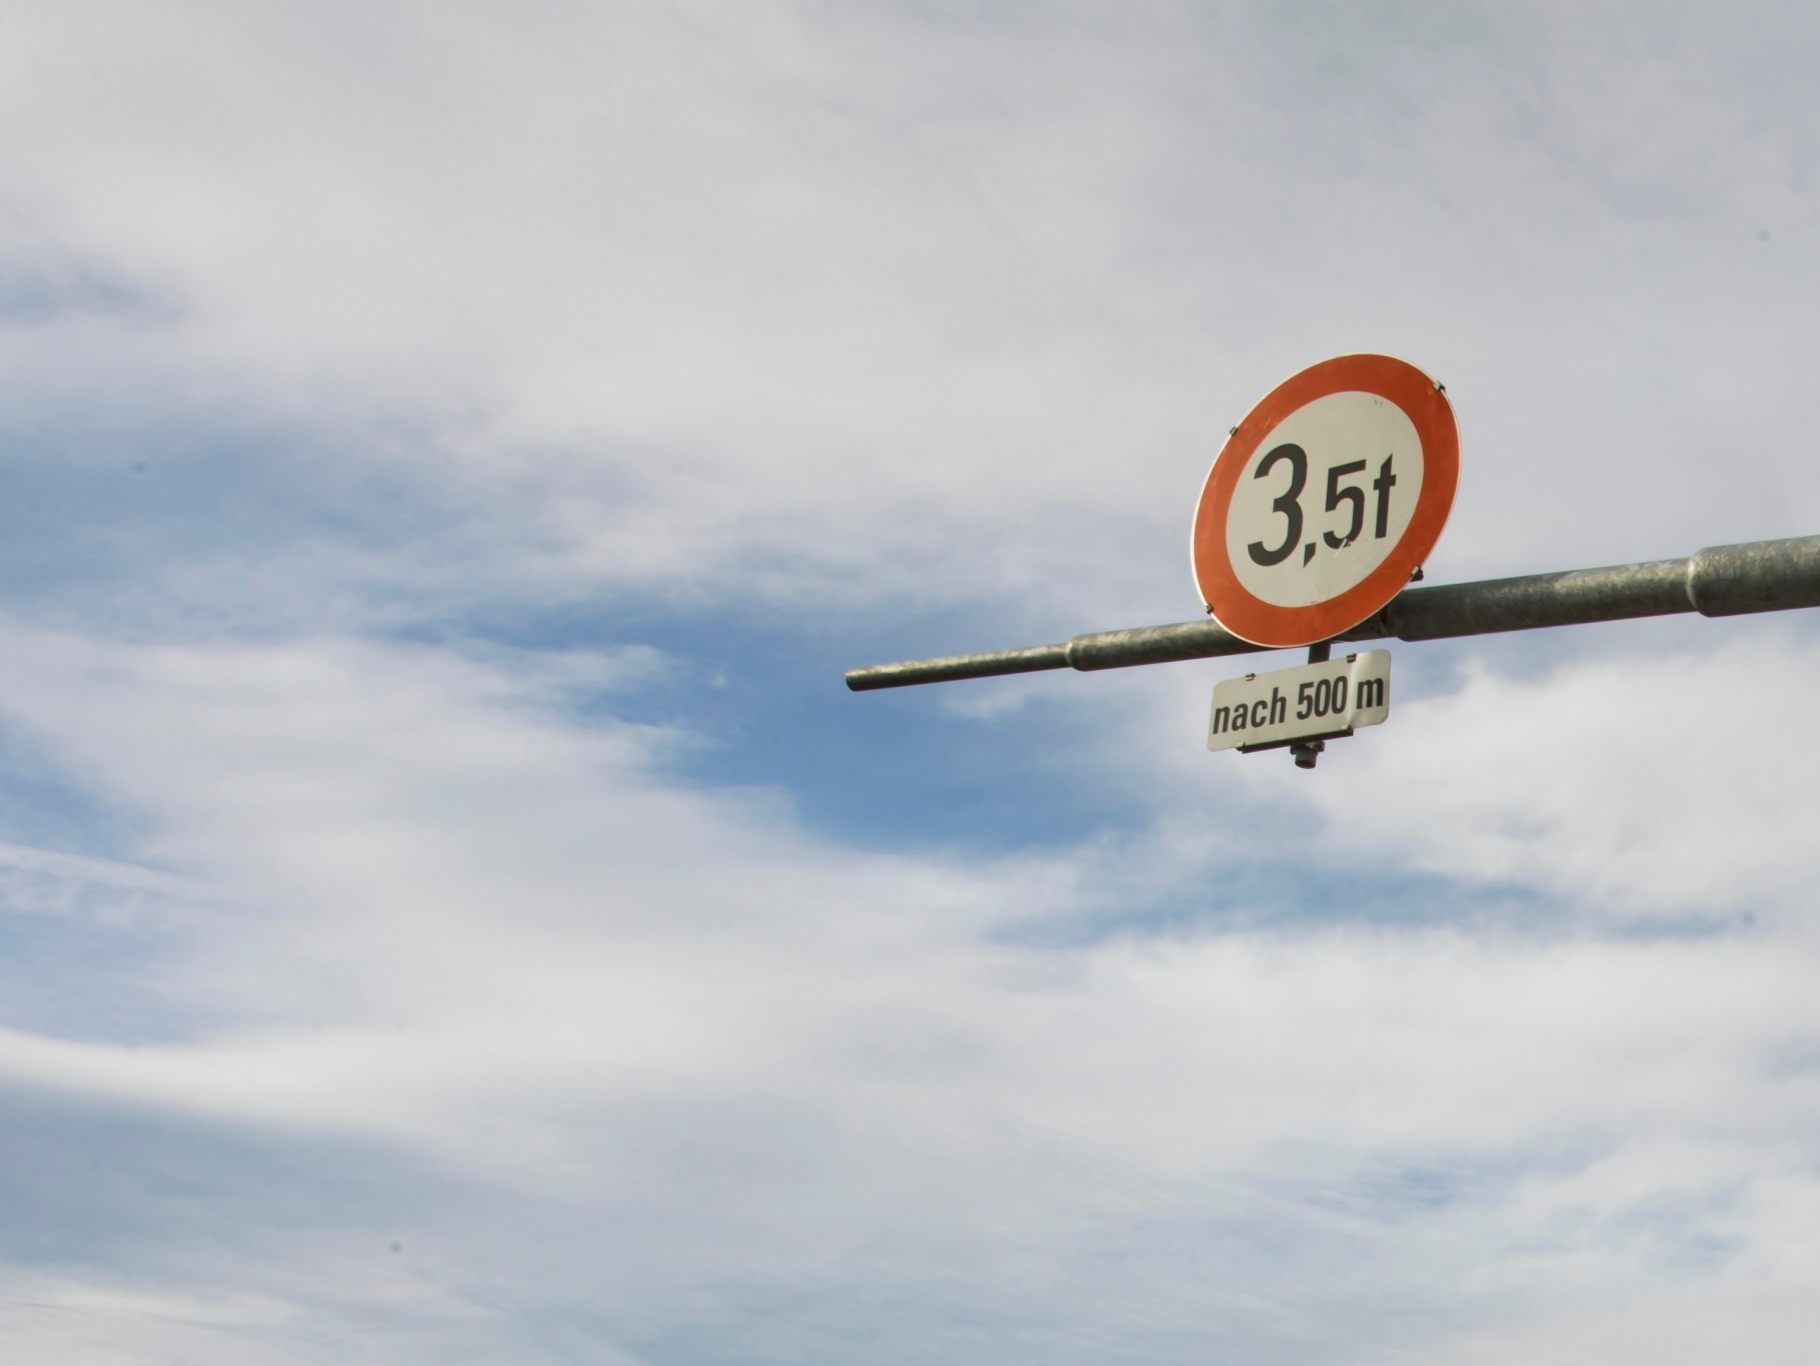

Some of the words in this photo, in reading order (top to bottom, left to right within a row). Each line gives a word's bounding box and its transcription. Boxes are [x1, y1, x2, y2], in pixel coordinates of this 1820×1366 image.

[1212, 687, 1287, 735] nach
[1296, 675, 1349, 720] 500
[1356, 677, 1385, 710] m
